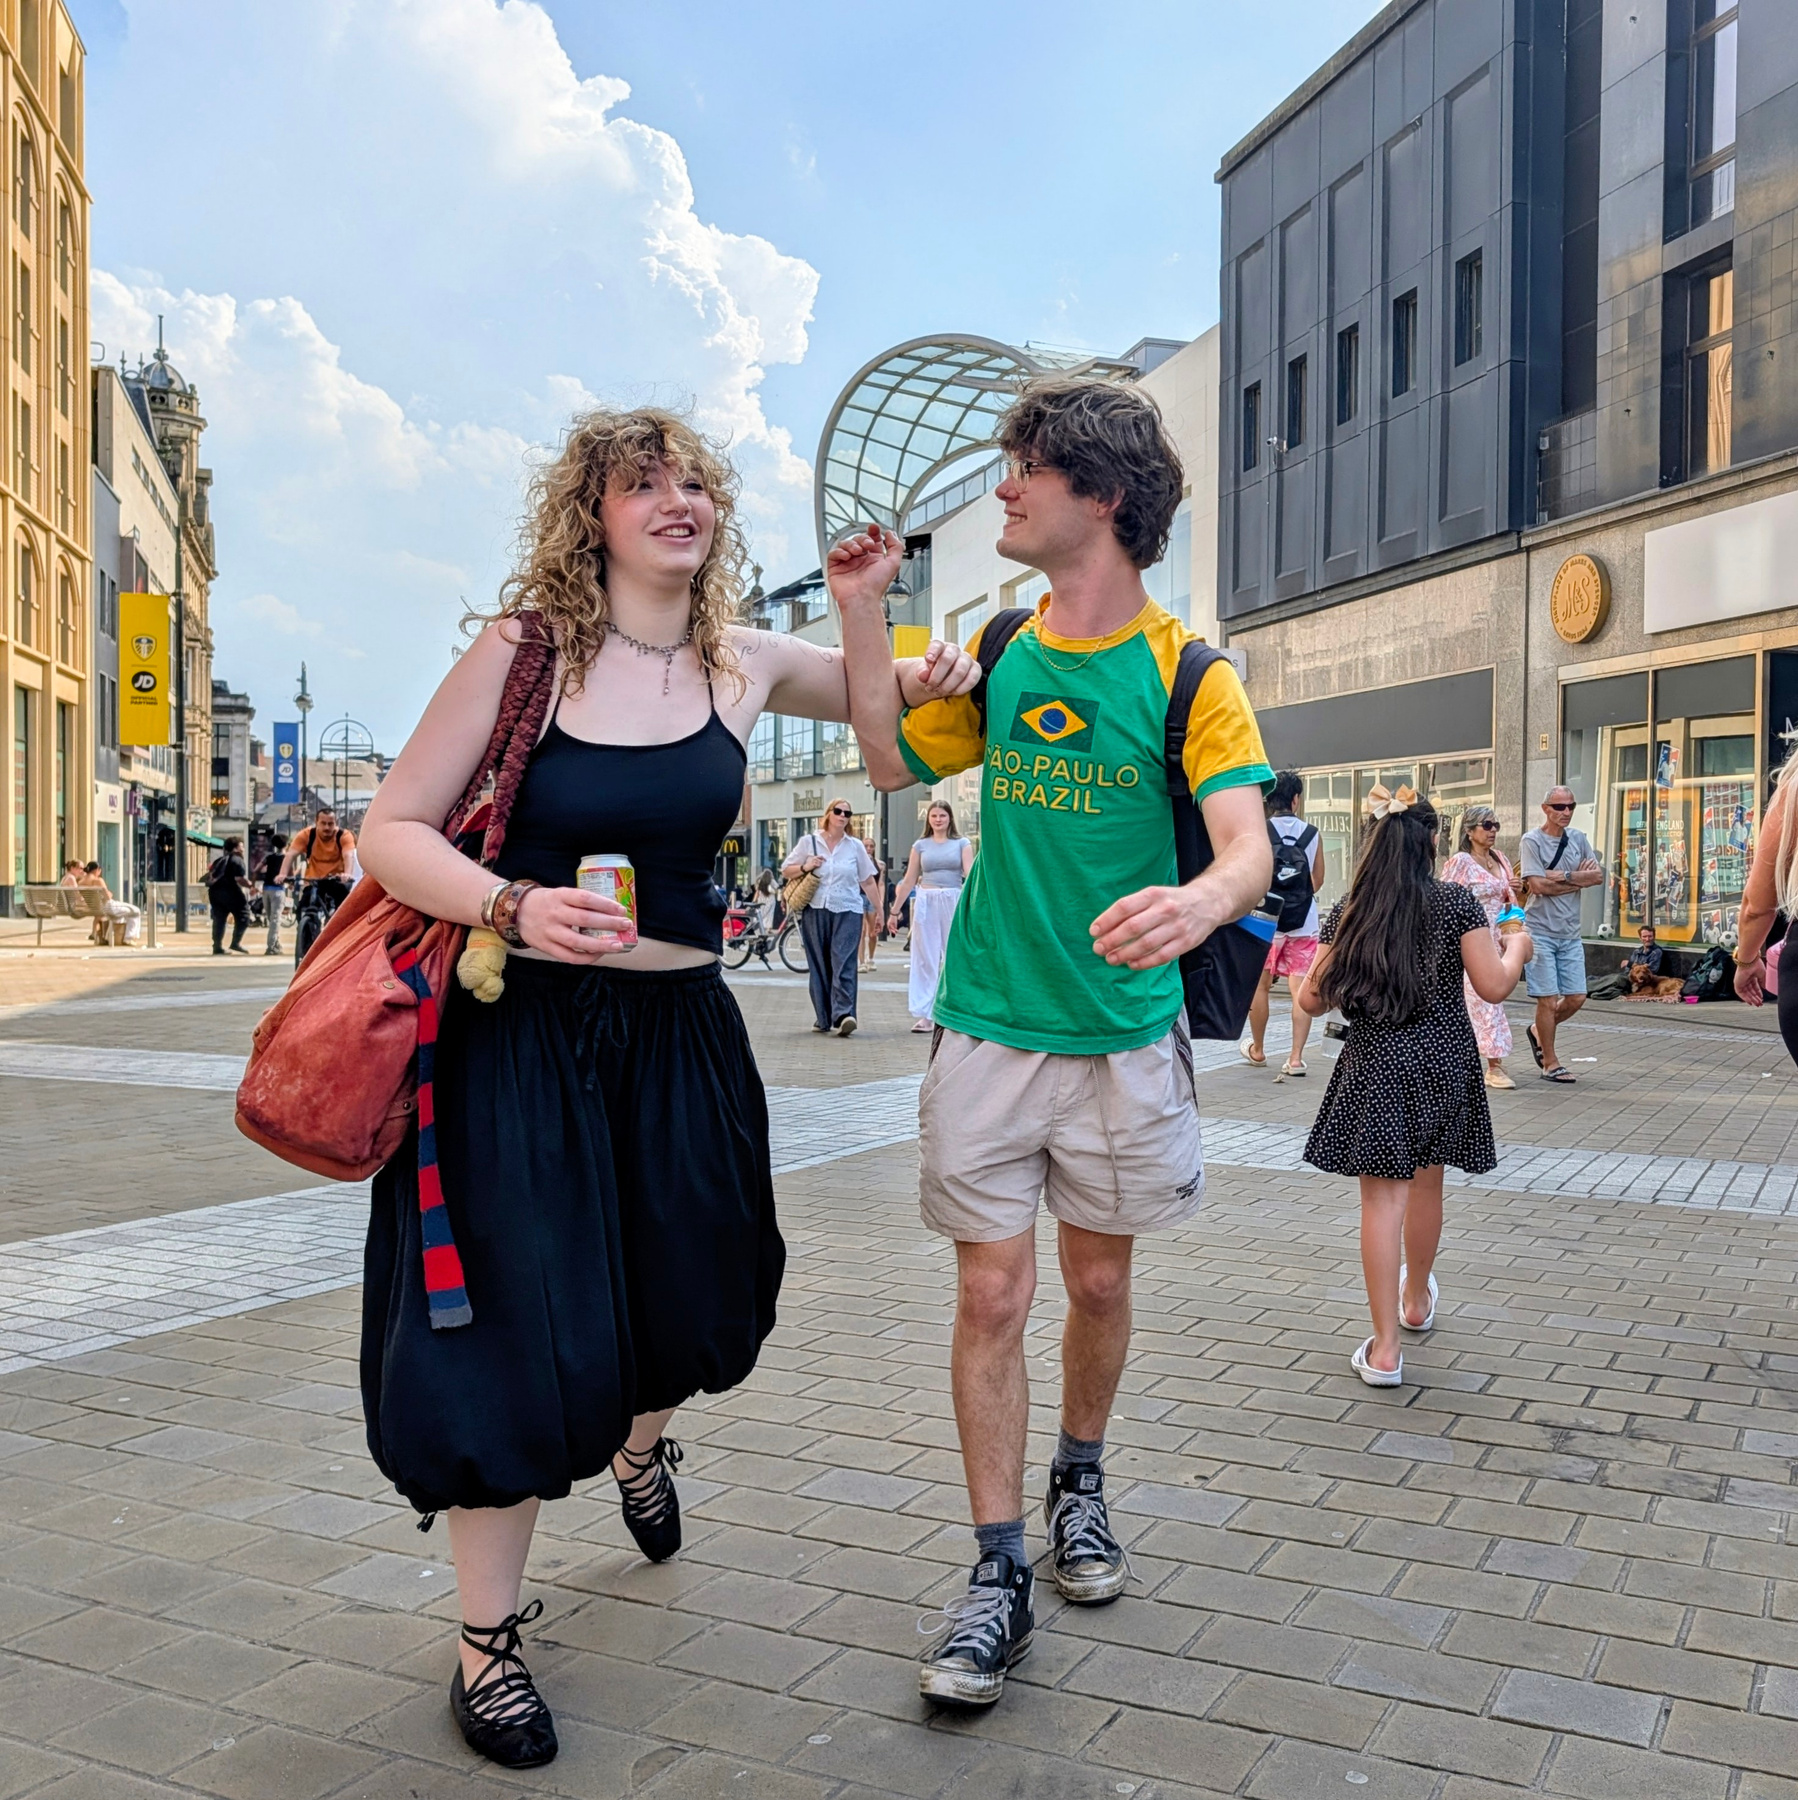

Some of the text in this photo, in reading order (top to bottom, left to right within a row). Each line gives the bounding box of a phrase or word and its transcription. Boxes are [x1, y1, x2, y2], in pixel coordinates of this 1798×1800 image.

[1562, 575, 1591, 622] M&S
[134, 674, 155, 689] JD
[987, 744, 1140, 789] ÃO-PAULO
[992, 776, 1103, 816] BRAZIL
[1656, 820, 1684, 831] ENGLAND
[1176, 1170, 1201, 1194] Reebok
